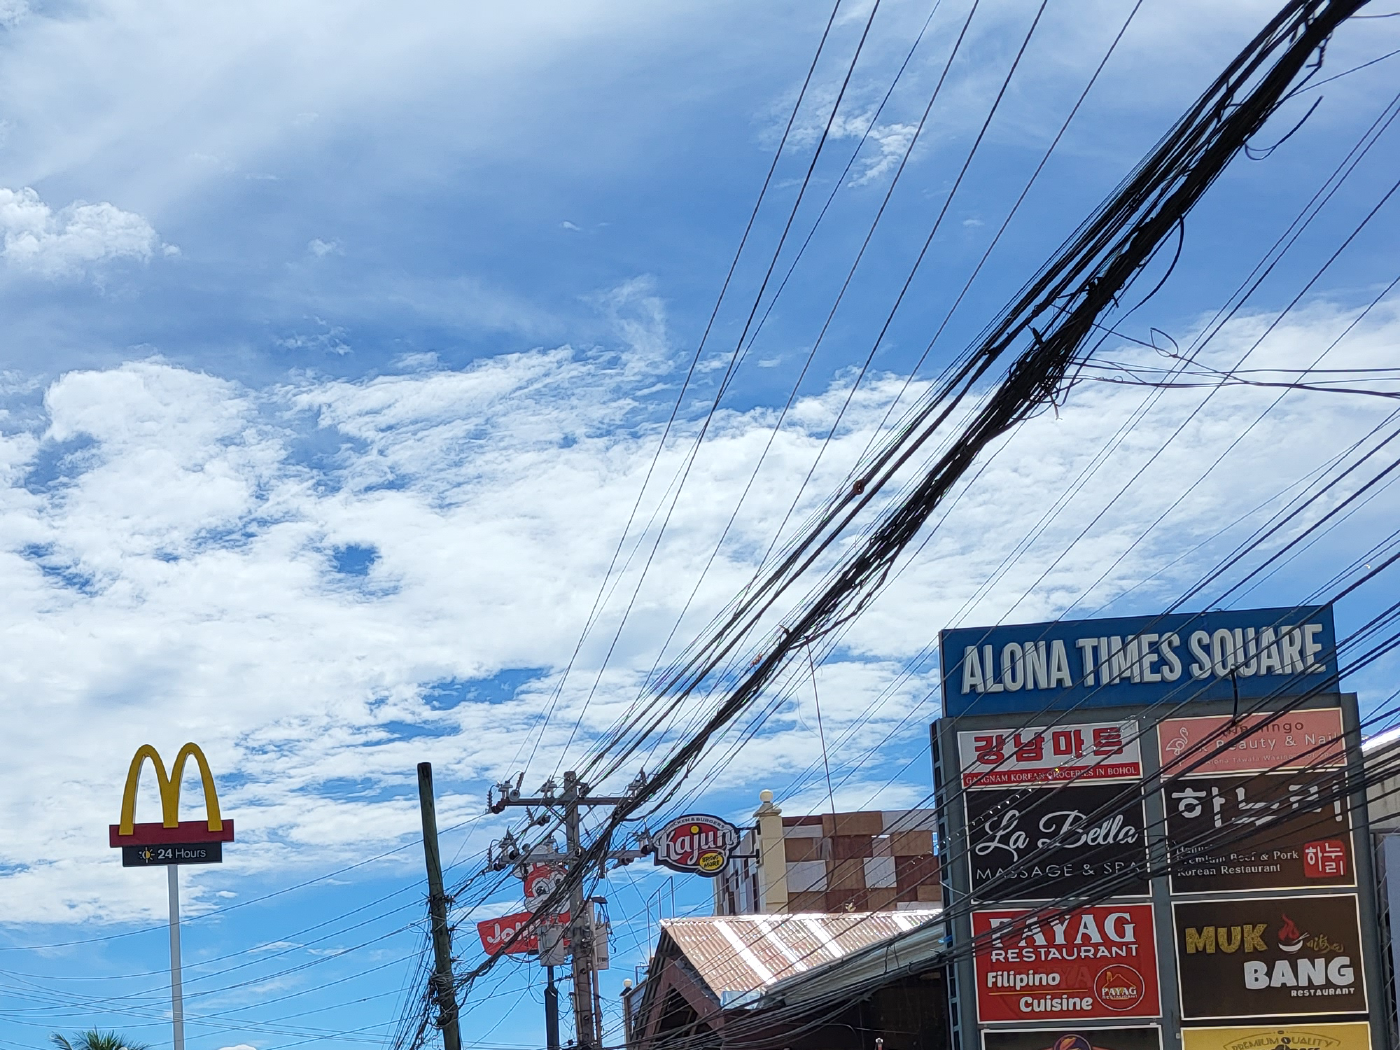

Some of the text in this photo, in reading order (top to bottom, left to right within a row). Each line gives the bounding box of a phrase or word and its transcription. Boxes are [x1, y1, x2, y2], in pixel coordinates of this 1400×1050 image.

[961, 623, 1327, 695] ALONA TIMES SQUARE
[974, 727, 1124, 765] 강남마트
[966, 766, 1138, 785] GANGNAM KOREAN GROCERIES IN BOHOL
[655, 825, 736, 865] Kajun
[975, 809, 1138, 863] La Bella
[157, 848, 207, 860] 24 Hours
[1260, 853, 1269, 862] &
[1273, 850, 1299, 861] Pork
[976, 861, 1140, 880] MASSAGE & SPA
[1177, 863, 1281, 877] Korean Restaurant
[989, 912, 1137, 948] PAYAG
[1185, 923, 1268, 954] MUK
[991, 944, 1139, 963] RESTAURANT
[987, 970, 1061, 991] Filipino
[1243, 956, 1355, 990] BANG
[1101, 987, 1137, 996] PAYAG
[1019, 994, 1093, 1013] Cuisine
